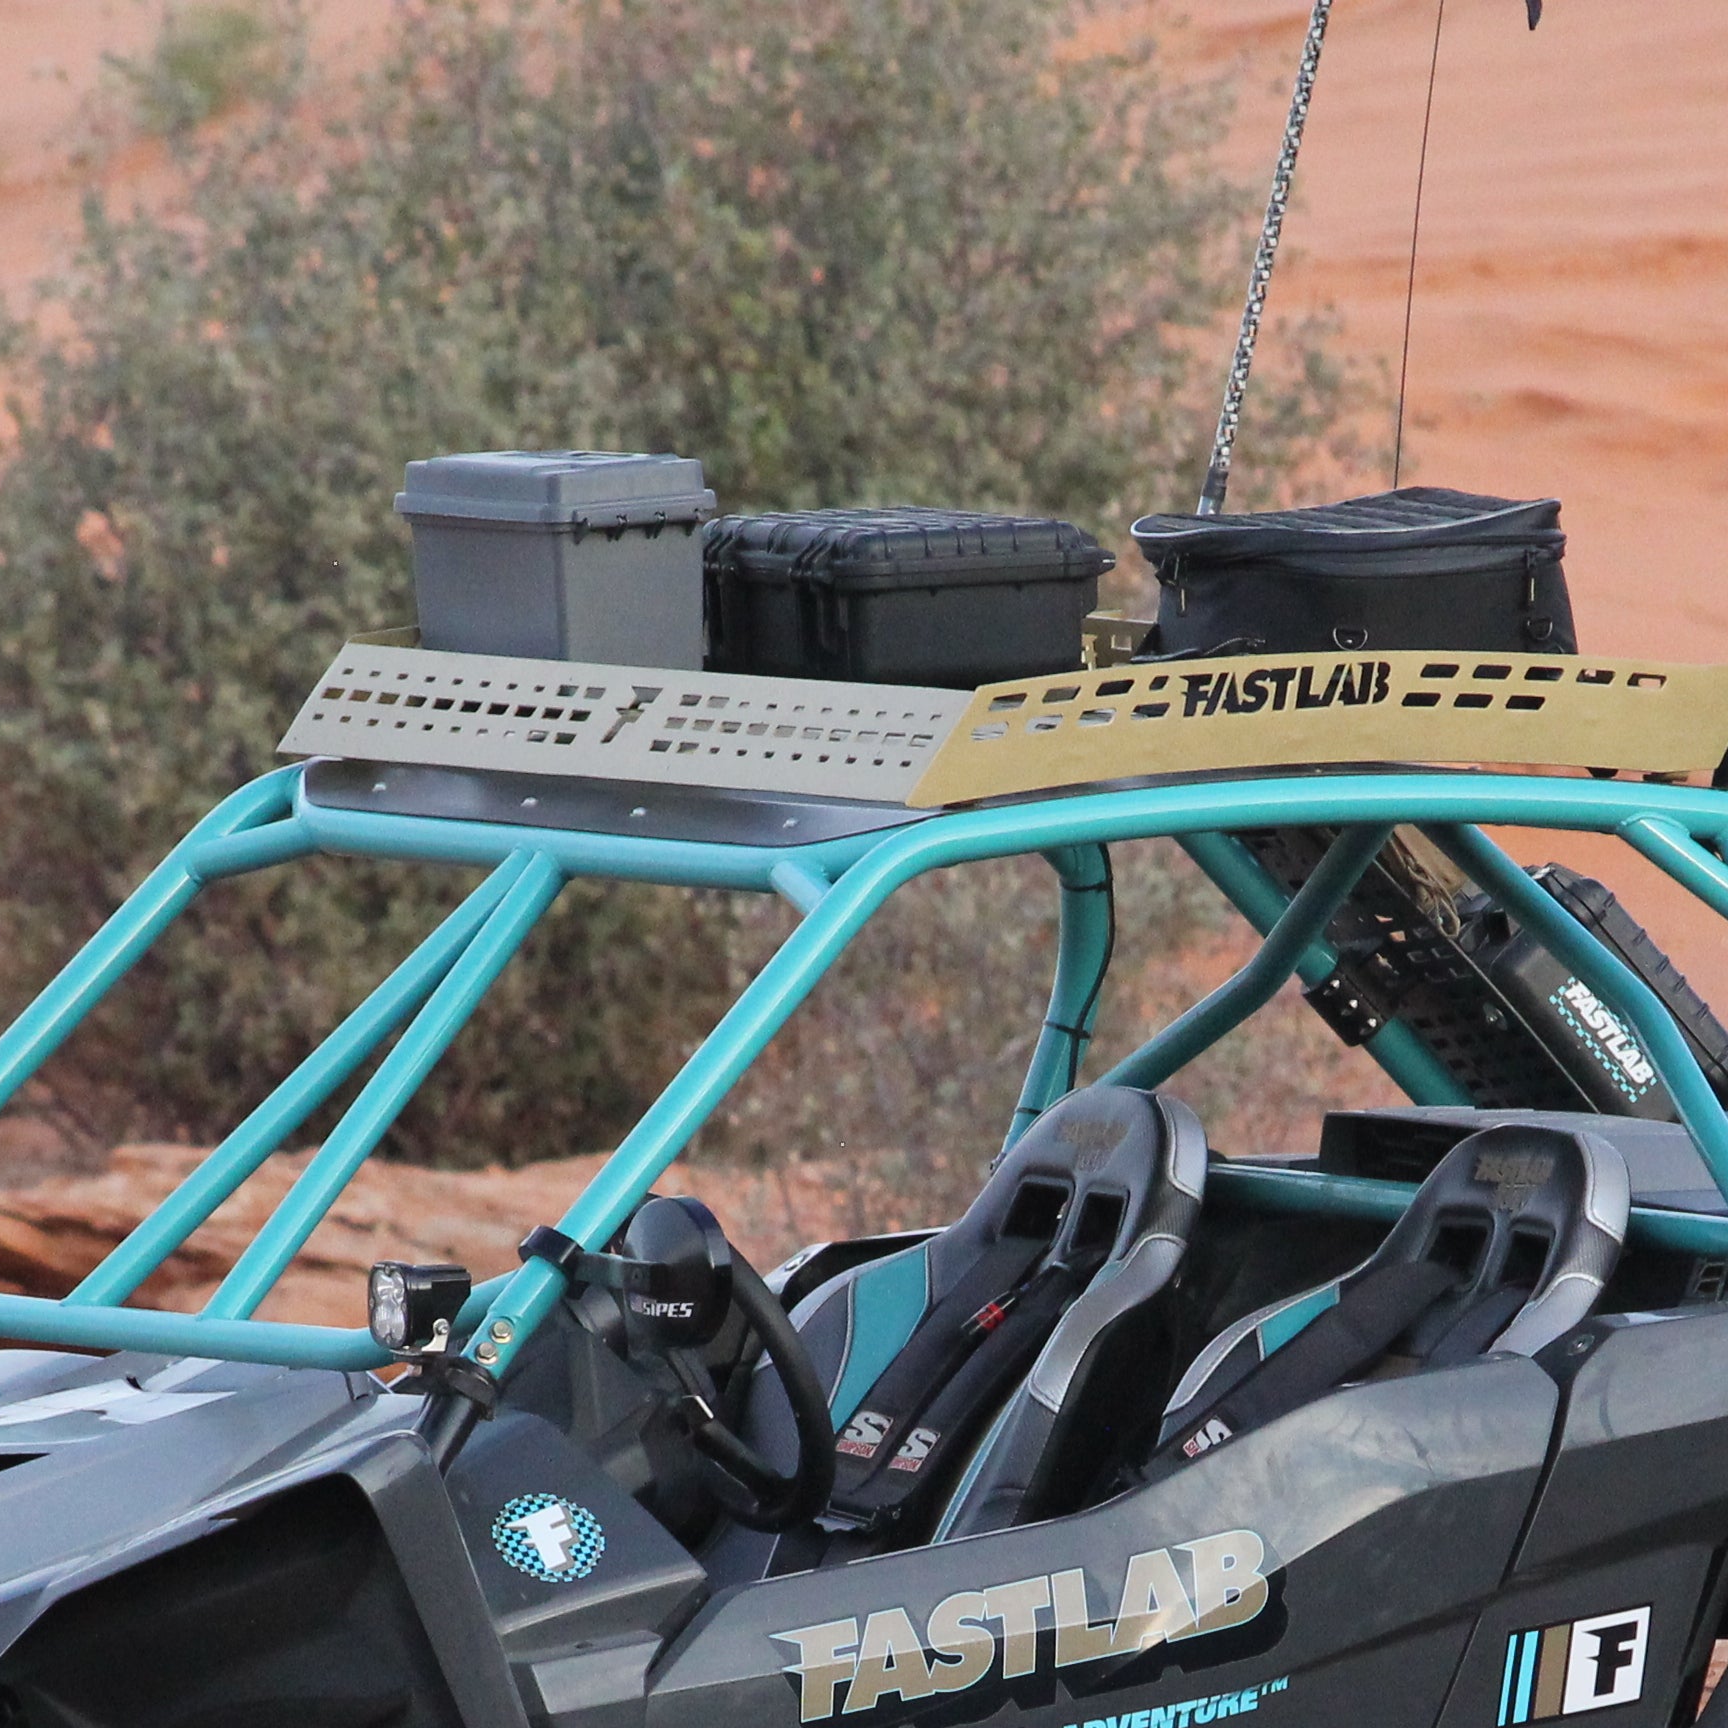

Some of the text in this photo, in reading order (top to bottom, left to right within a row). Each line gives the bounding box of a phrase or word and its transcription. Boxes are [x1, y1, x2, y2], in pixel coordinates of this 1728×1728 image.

[1178, 661, 1391, 718] FASTLAB
[1564, 979, 1655, 1084] FASTLAB
[643, 1302, 694, 1318] SIPES
[769, 1529, 1270, 1724] FASTLAB
[1581, 1620, 1639, 1697] F
